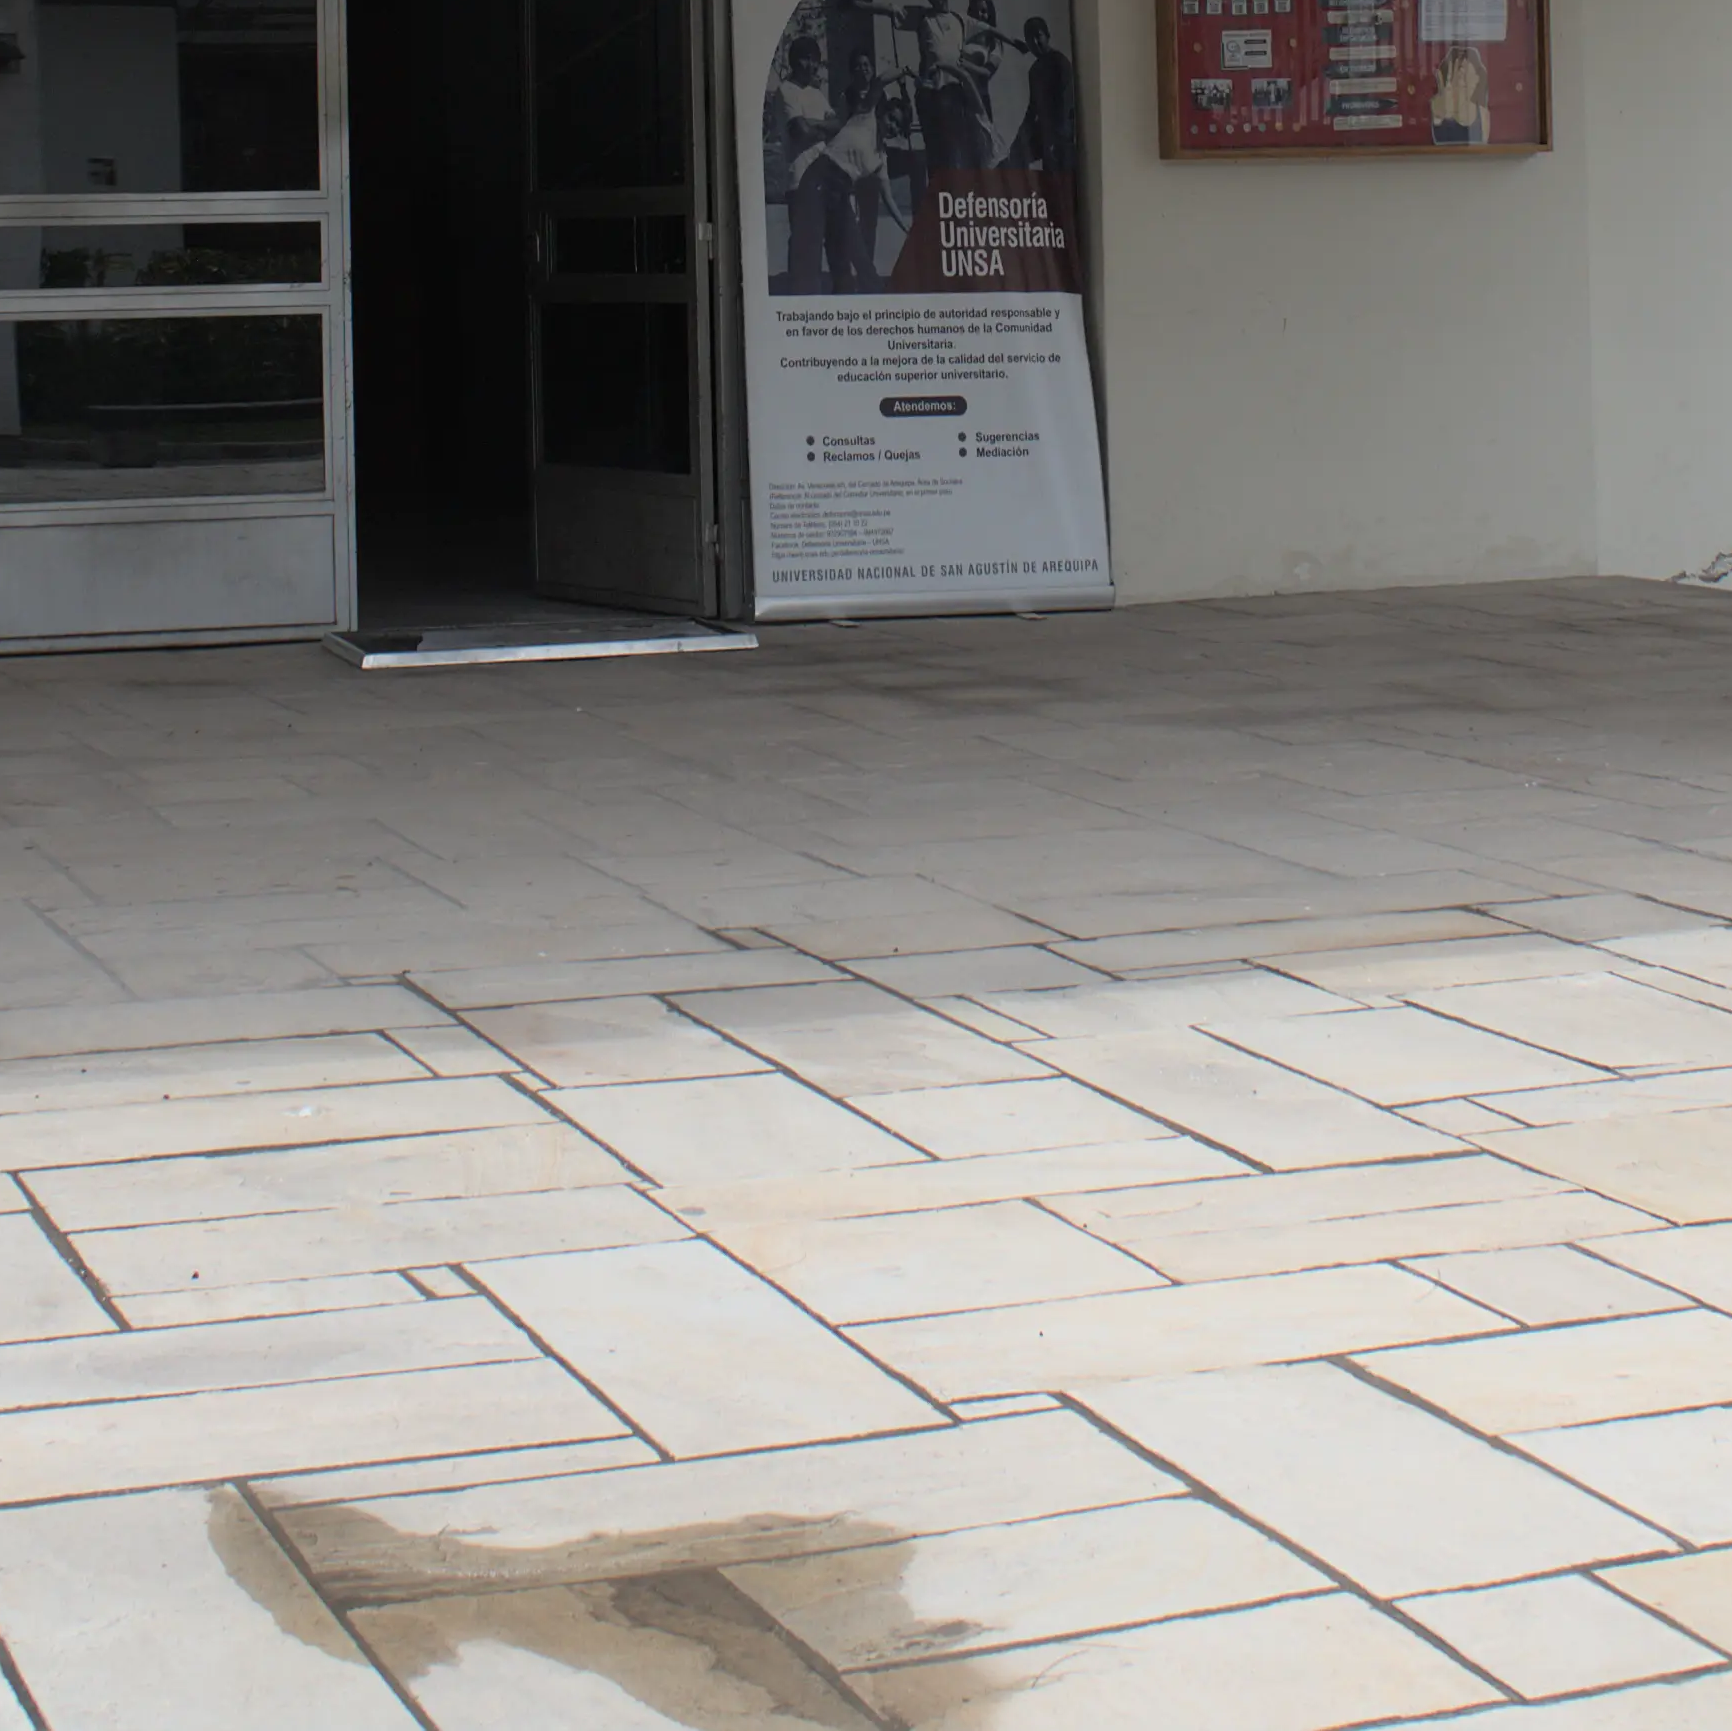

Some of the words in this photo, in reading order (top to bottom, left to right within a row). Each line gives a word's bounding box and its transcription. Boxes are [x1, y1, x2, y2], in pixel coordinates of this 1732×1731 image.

[939, 191, 1047, 219] Defensoría
[940, 221, 1065, 249] Universitaria
[942, 250, 1004, 277] UNSA
[776, 311, 834, 323] Trabajando
[837, 311, 860, 323] bajo
[863, 310, 871, 320] el
[875, 309, 920, 321] principio
[924, 309, 935, 319] de
[939, 308, 987, 318] autoridad
[991, 308, 1051, 319] responsable
[1055, 310, 1060, 319] y
[786, 329, 799, 337] en
[802, 326, 828, 336] favor
[832, 326, 843, 335] de
[847, 326, 863, 335] los
[866, 325, 914, 335] derechos
[918, 324, 965, 334] humanos
[968, 323, 980, 333] de
[984, 323, 992, 333] la
[996, 322, 1052, 333] Comunidad
[781, 357, 858, 369] Contribuyendo
[871, 357, 879, 365] la
[883, 355, 917, 367] mejora
[921, 355, 933, 365] de
[937, 355, 945, 364] la
[949, 354, 984, 364] calidad
[988, 353, 1003, 363] del
[1007, 353, 1045, 363] servicio
[1048, 353, 1060, 362] de
[838, 371, 891, 382] educación
[895, 371, 937, 382] superior
[941, 369, 1007, 379] universitario.
[894, 401, 956, 412] Atendemos:
[823, 436, 875, 446] Consultas
[976, 431, 1039, 444] Sugerencias
[824, 451, 875, 462] Reclamos
[885, 450, 920, 462] Quejas
[977, 447, 1029, 457] Mediación
[773, 569, 852, 583] UNIVERSIDAD
[858, 566, 915, 579] NACIONAL
[921, 565, 934, 577] DE
[941, 564, 963, 576] SAN
[968, 560, 1017, 575] AGUSTÍN
[1023, 561, 1035, 573] DE
[1043, 559, 1098, 572] AREQUIPA
